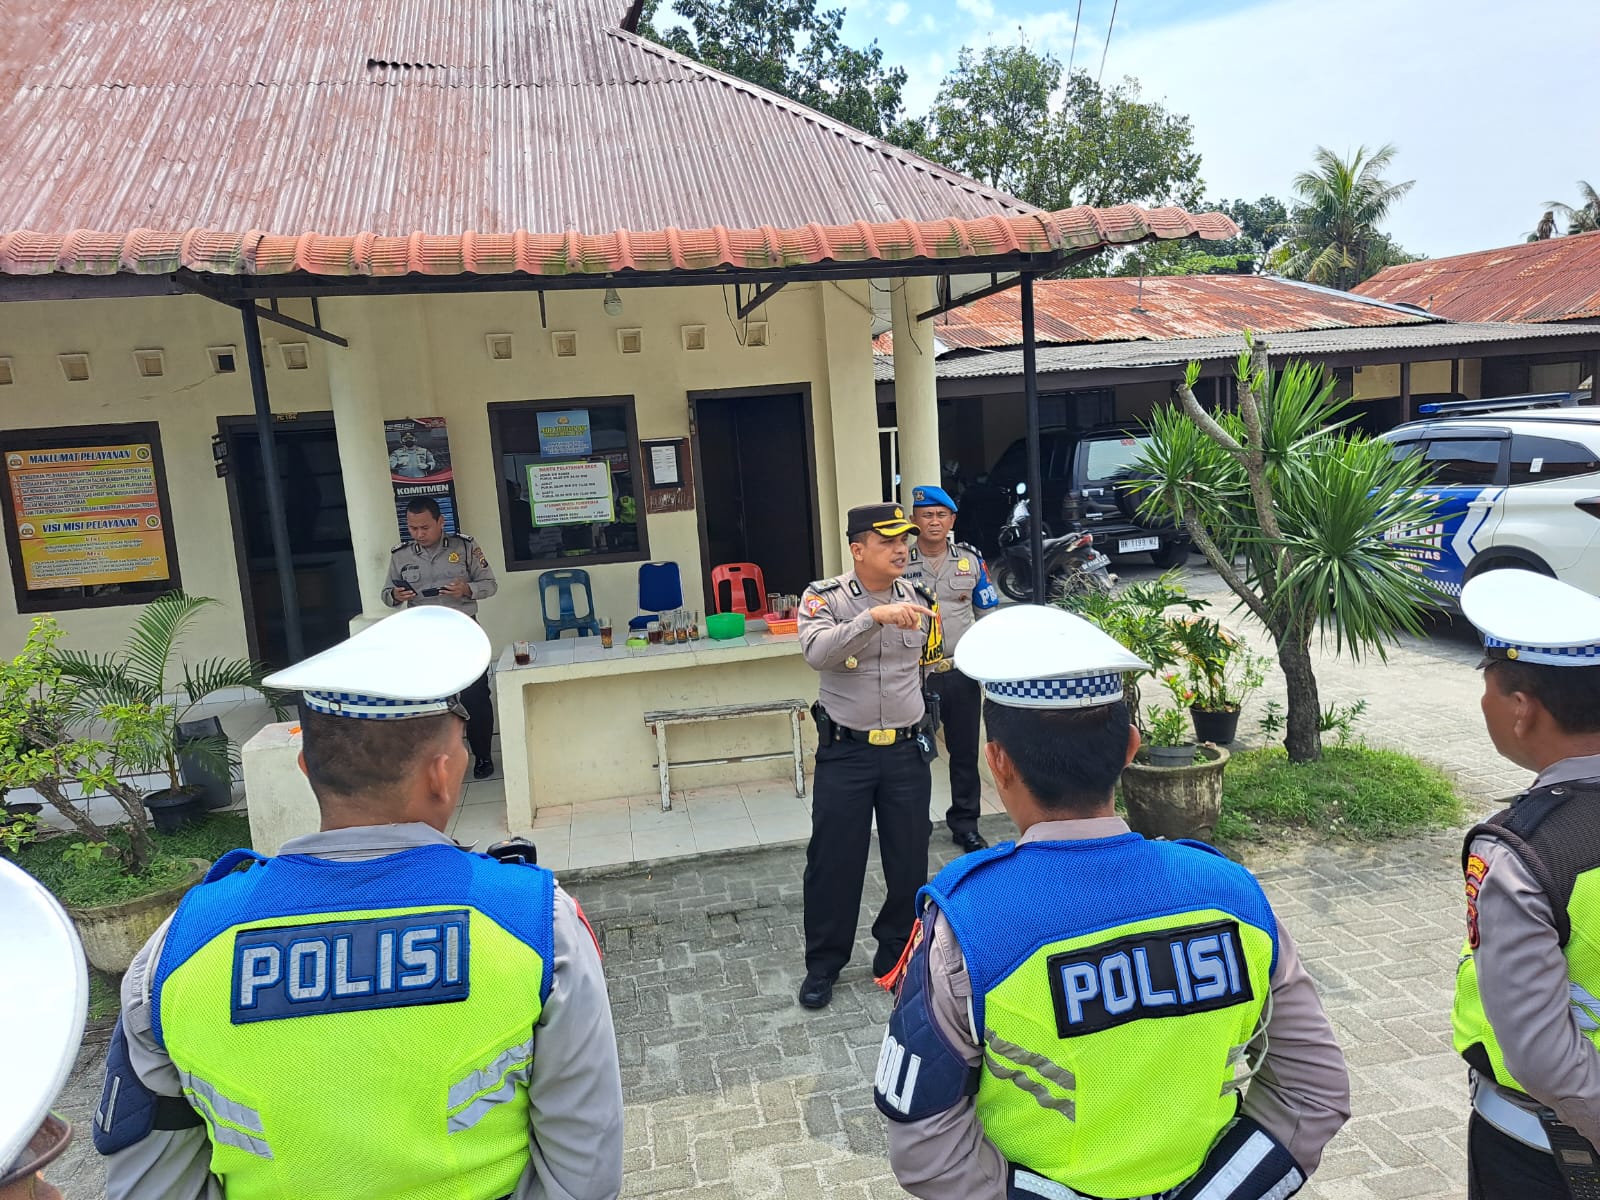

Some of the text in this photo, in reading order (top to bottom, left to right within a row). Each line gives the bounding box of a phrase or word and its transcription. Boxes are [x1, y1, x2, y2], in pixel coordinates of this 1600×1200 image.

[29, 449, 131, 464] MAKLUMAT PELAYANAN
[397, 484, 449, 495] KOMITMEN
[42, 518, 138, 533] VISI MISI PELAYANAN
[239, 921, 460, 1007] POLISI
[1061, 932, 1241, 1025] POLISI
[875, 1026, 922, 1115] OLI
